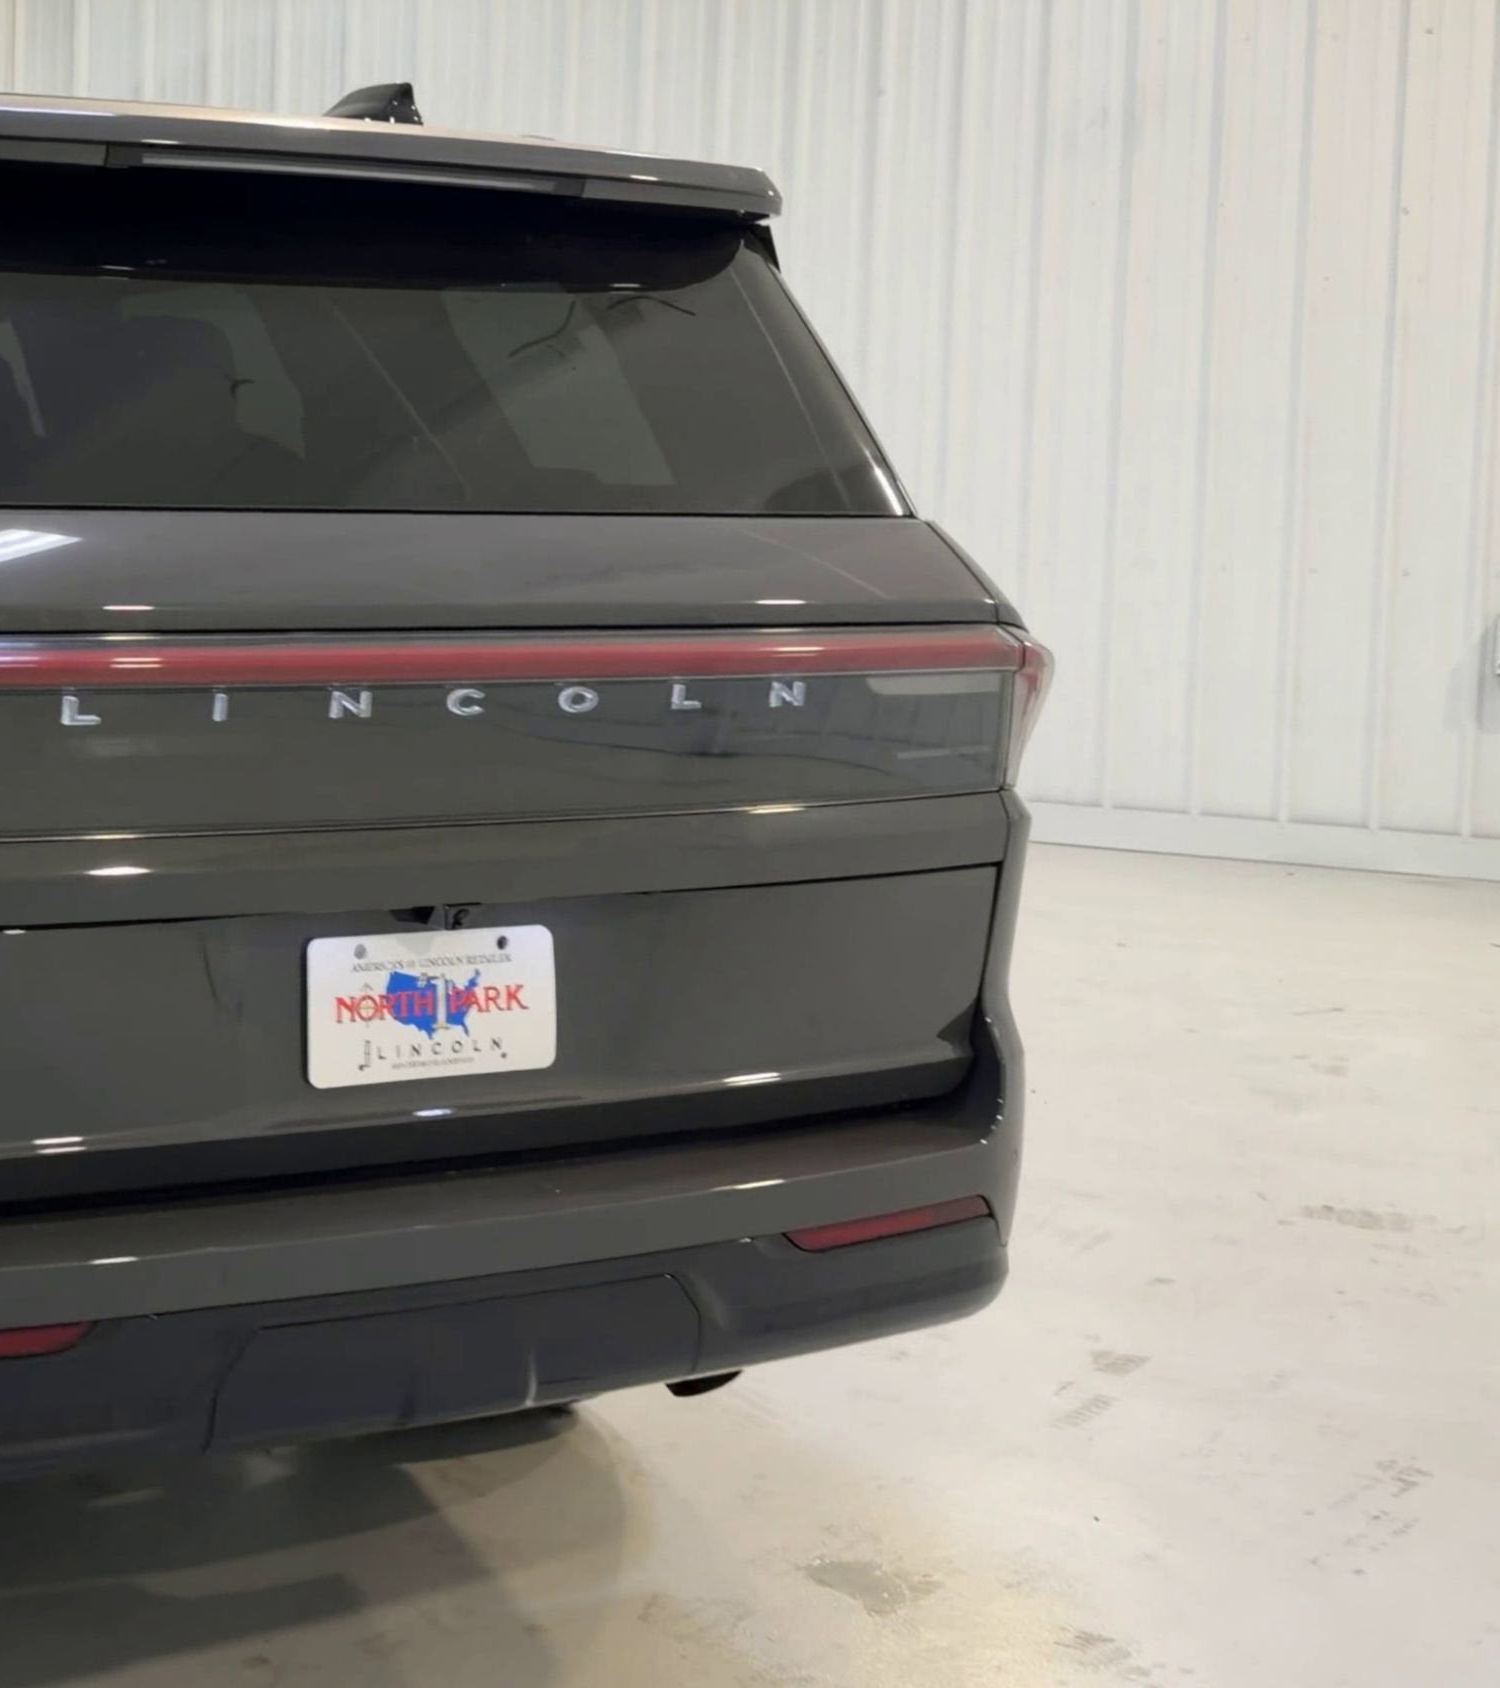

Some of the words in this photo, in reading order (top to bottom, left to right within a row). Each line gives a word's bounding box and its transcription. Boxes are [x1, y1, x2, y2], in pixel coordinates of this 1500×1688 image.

[60, 681, 806, 726] LINCOLN
[335, 989, 434, 1024] NORTH
[450, 984, 530, 1015] PARK
[376, 1036, 503, 1060] LINCOLN
